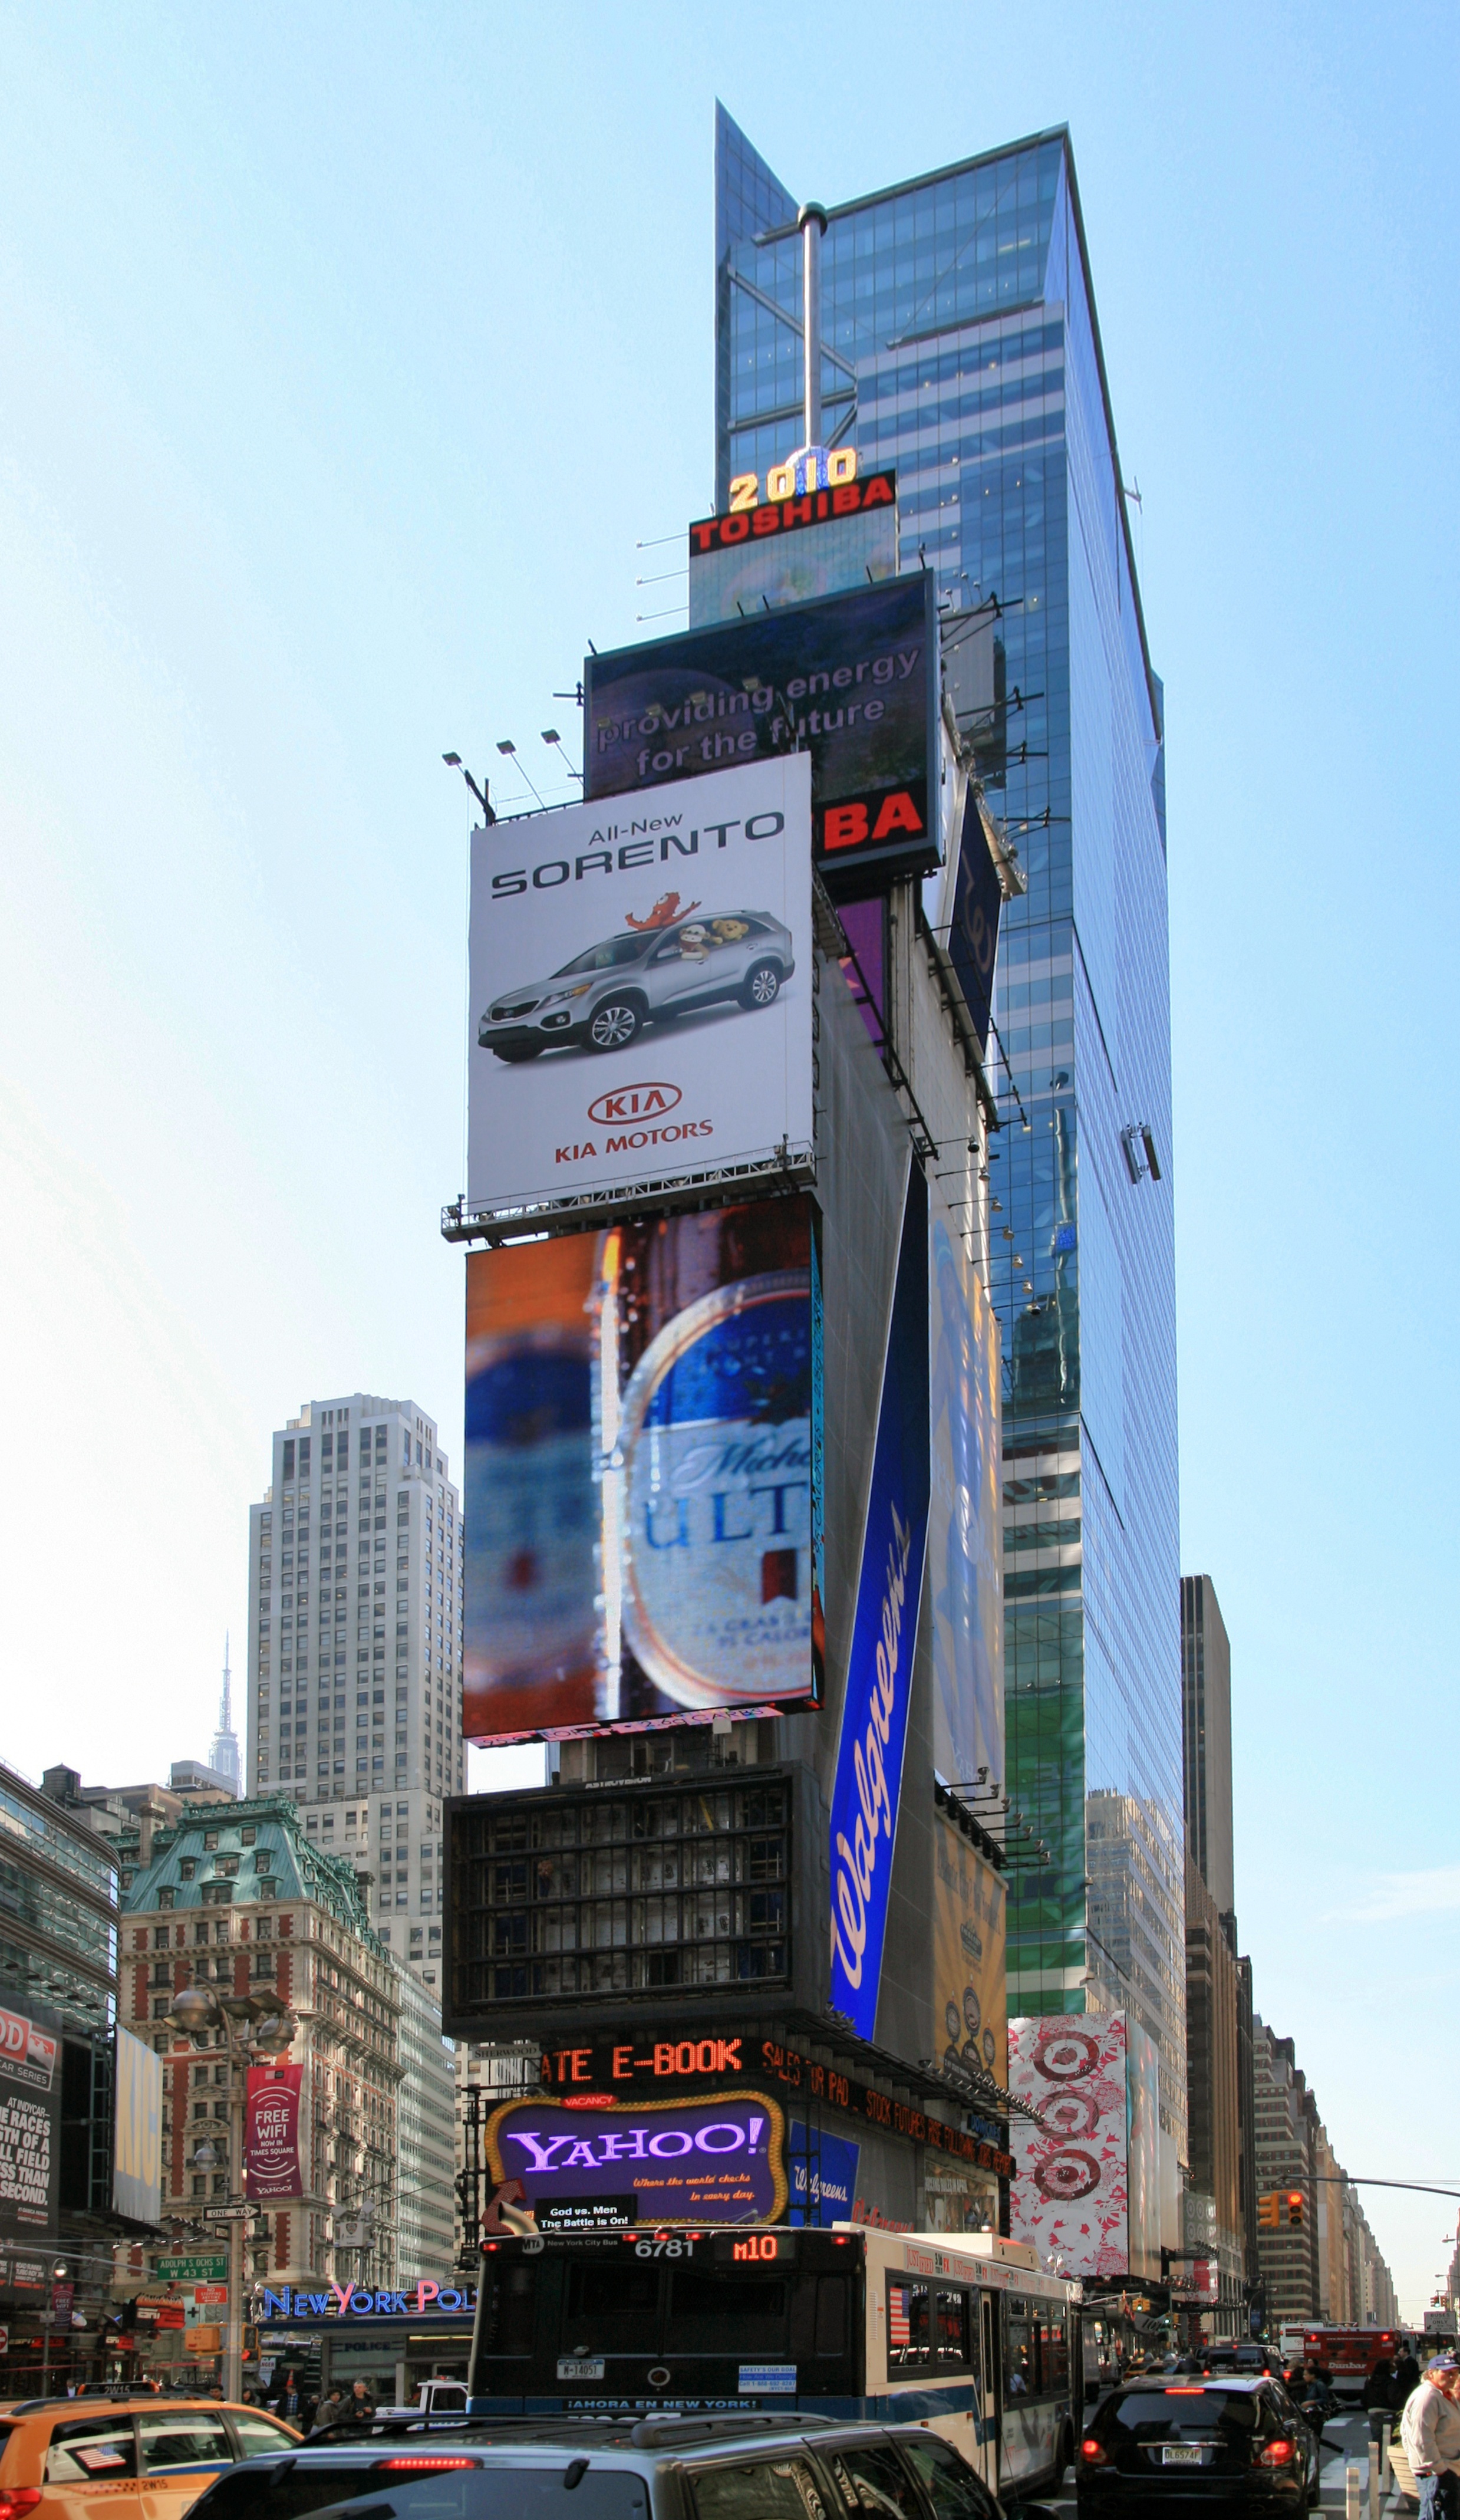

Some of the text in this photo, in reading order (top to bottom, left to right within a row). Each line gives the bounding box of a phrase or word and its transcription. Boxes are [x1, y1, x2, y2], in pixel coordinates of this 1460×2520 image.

[729, 447, 857, 513] 2010
[691, 476, 892, 551] TOSHIBA
[596, 649, 919, 752] providing energy
[637, 698, 885, 776] for the future
[588, 814, 683, 846] All-New
[492, 811, 785, 899] SORENTO
[605, 1090, 667, 1118] KIA
[555, 1119, 713, 1163] KIA MOTORS
[830, 1500, 911, 1990] Walgreens
[474, 2047, 537, 2059] SHERWOOD
[612, 2039, 742, 2078] E-BOOK
[18, 2067, 47, 2084] SERIES
[7, 2097, 17, 2107] AT
[565, 2095, 613, 2107] VACANCY
[10, 2111, 51, 2136] RACES
[255, 2109, 290, 2124] FREE
[257, 2124, 286, 2139] WIFI
[22, 2131, 39, 2150] OF
[41, 2137, 50, 2154] A
[270, 2147, 294, 2155] SQUARE
[507, 2118, 764, 2172] YAHOO!
[16, 2147, 50, 2170] FIELD
[18, 2166, 50, 2189] THAN
[633, 2173, 750, 2187] Where the world checks
[794, 2166, 848, 2203] Wlgreens
[0, 2180, 48, 2206] SECOND.
[255, 2185, 292, 2195] YAHOO!
[703, 2192, 730, 2202] every
[733, 2190, 755, 2201] day.
[550, 2208, 572, 2216] God
[541, 2219, 561, 2228] The
[563, 2218, 594, 2227] Battle
[610, 2216, 628, 2225] On!
[635, 2239, 694, 2257] 6781
[160, 2259, 186, 2268] ADOLPH
[196, 2258, 213, 2266] OCHS
[216, 2258, 224, 2266] ST
[943, 2258, 950, 2272] FX
[170, 2268, 214, 2278] W 43 ST
[982, 2266, 987, 2280] FX
[265, 2280, 479, 2317] NEW YORK POL
[344, 2341, 391, 2351] POLICE
[104, 2385, 130, 2394] 2W15
[635, 2400, 657, 2409] EN
[663, 2400, 701, 2409] NEW
[704, 2400, 756, 2409] YORK!
[141, 2479, 167, 2490] 2W15
